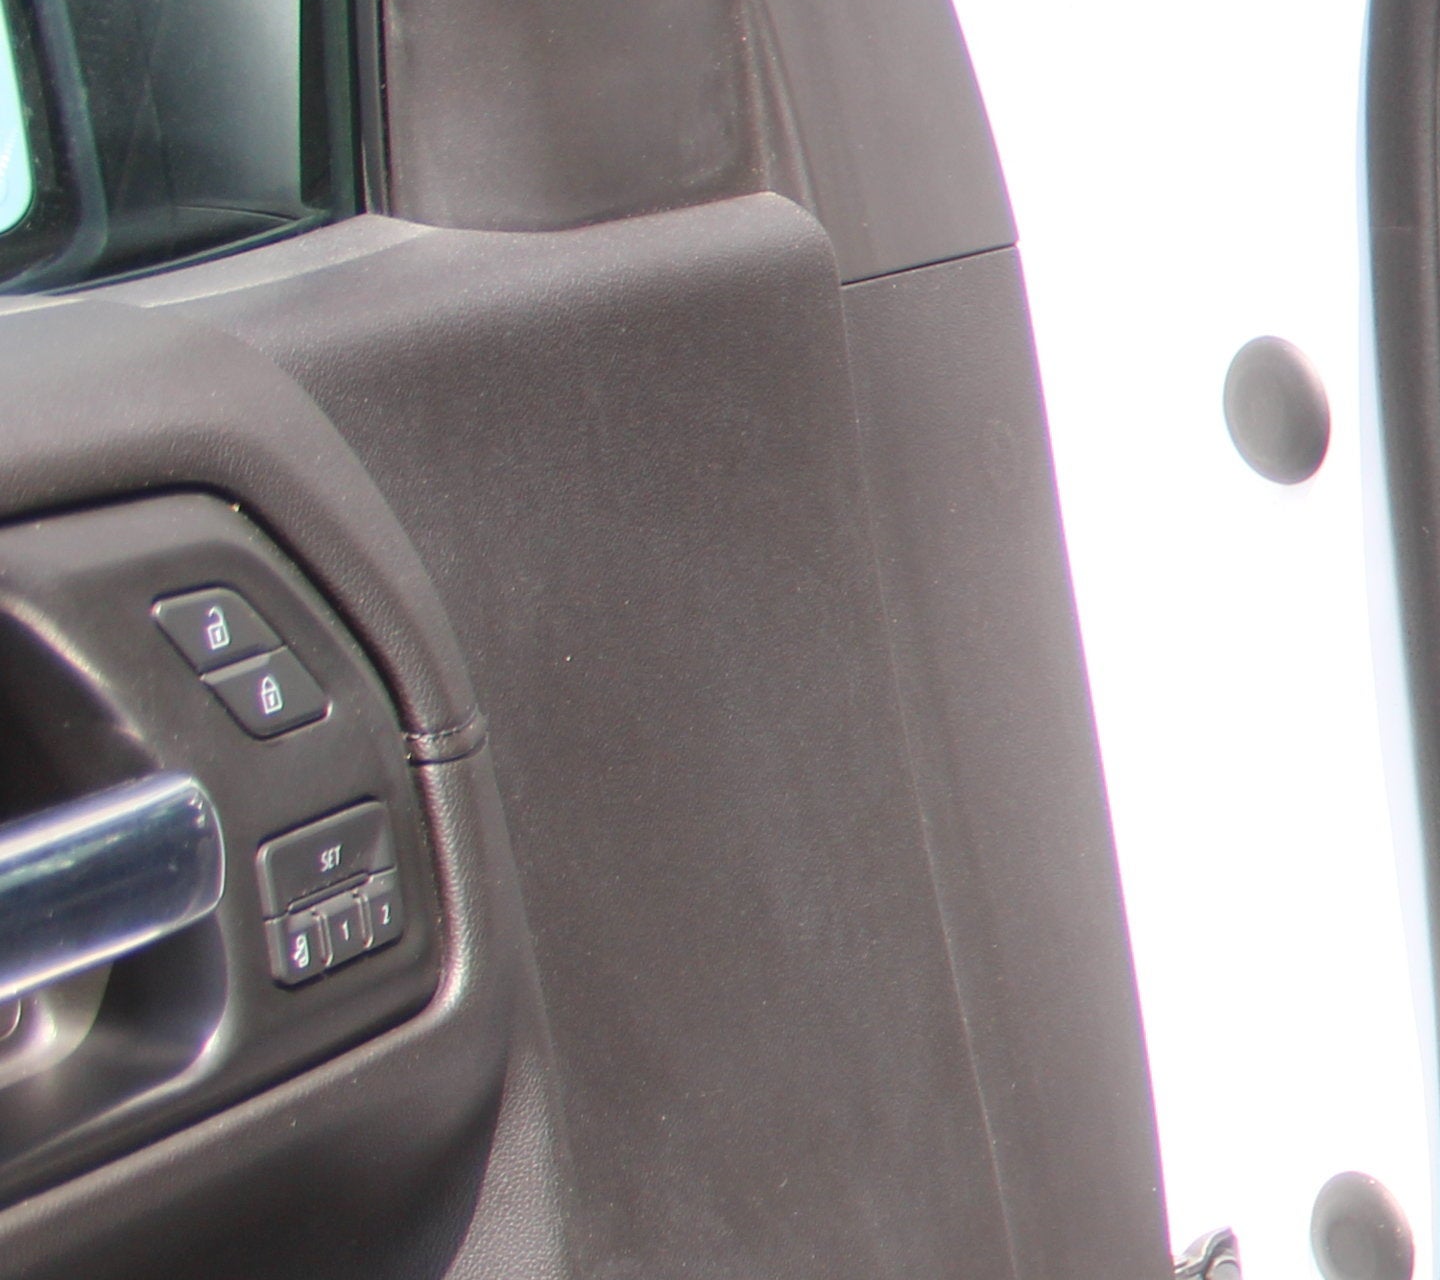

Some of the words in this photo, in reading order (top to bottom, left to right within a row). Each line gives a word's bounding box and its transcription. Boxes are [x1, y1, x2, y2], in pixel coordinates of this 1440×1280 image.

[320, 844, 342, 872] SET
[381, 904, 391, 925] 2
[341, 921, 350, 941] 1
